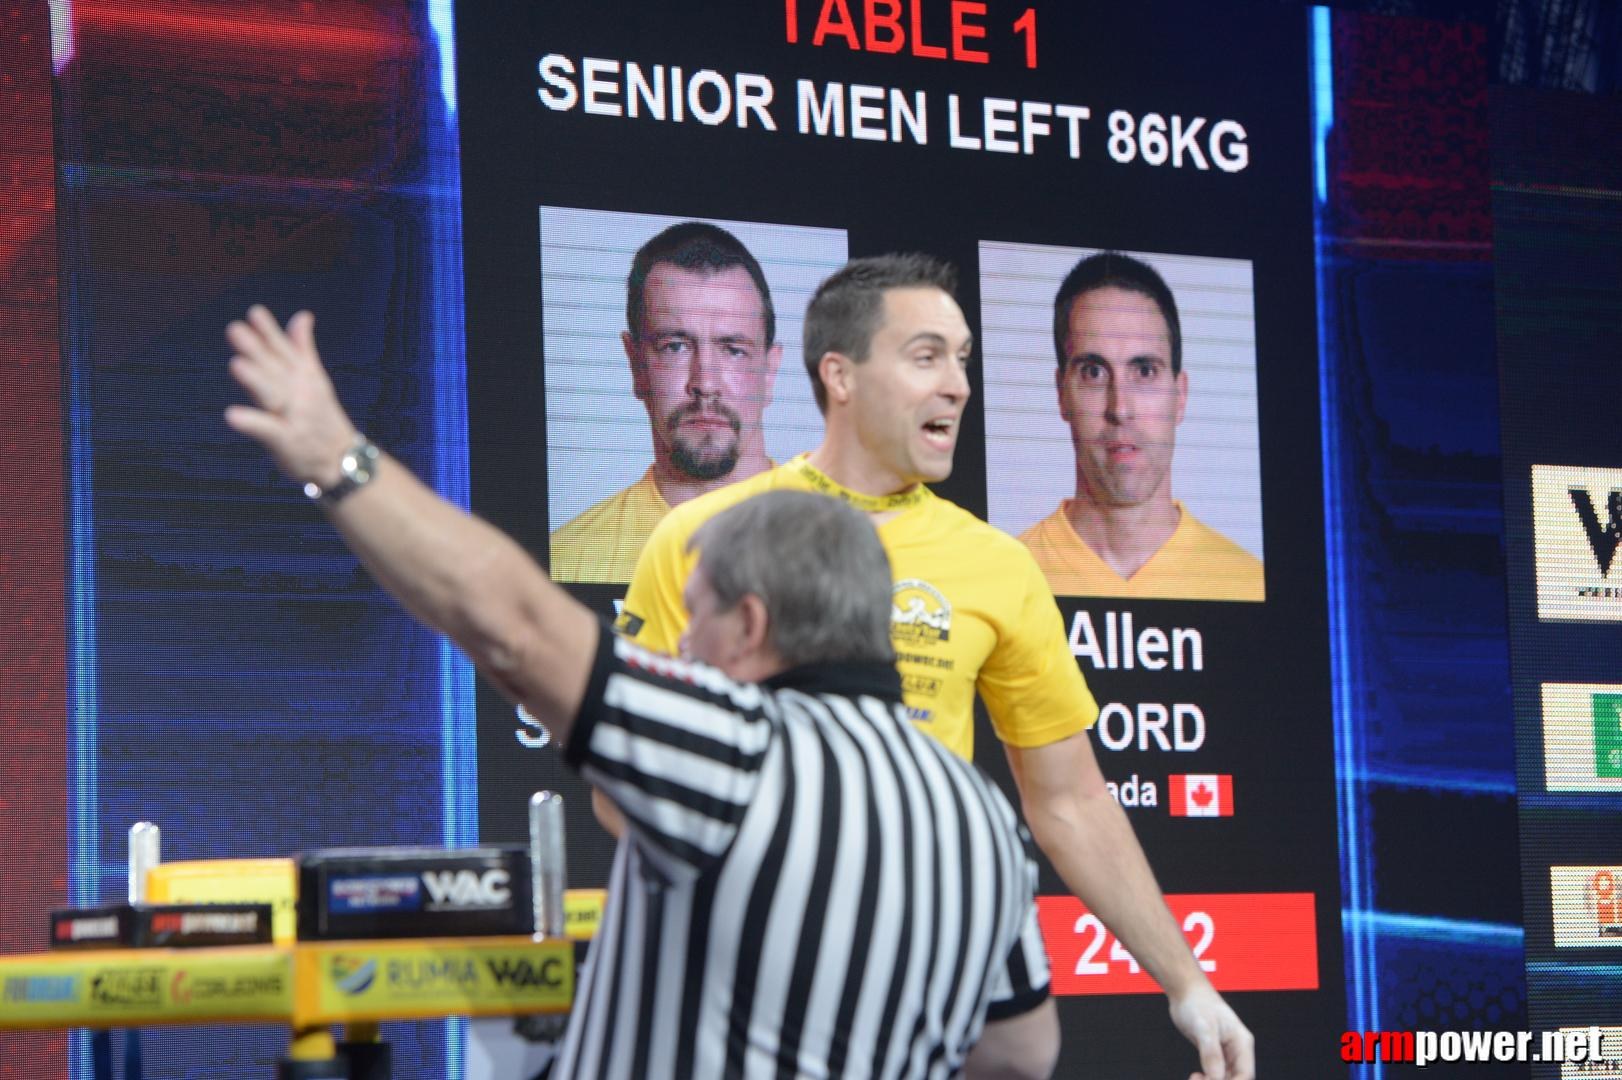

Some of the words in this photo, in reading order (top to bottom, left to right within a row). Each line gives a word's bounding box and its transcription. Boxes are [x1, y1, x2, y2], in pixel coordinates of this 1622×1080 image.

[1013, 8, 1038, 69] 1
[537, 53, 778, 132] SENIOR
[796, 78, 930, 146] MEN
[947, 93, 1092, 160] LEFT
[1106, 109, 1250, 174] 86KG
[1068, 610, 1204, 671] Allen
[1086, 702, 1206, 752] ORD
